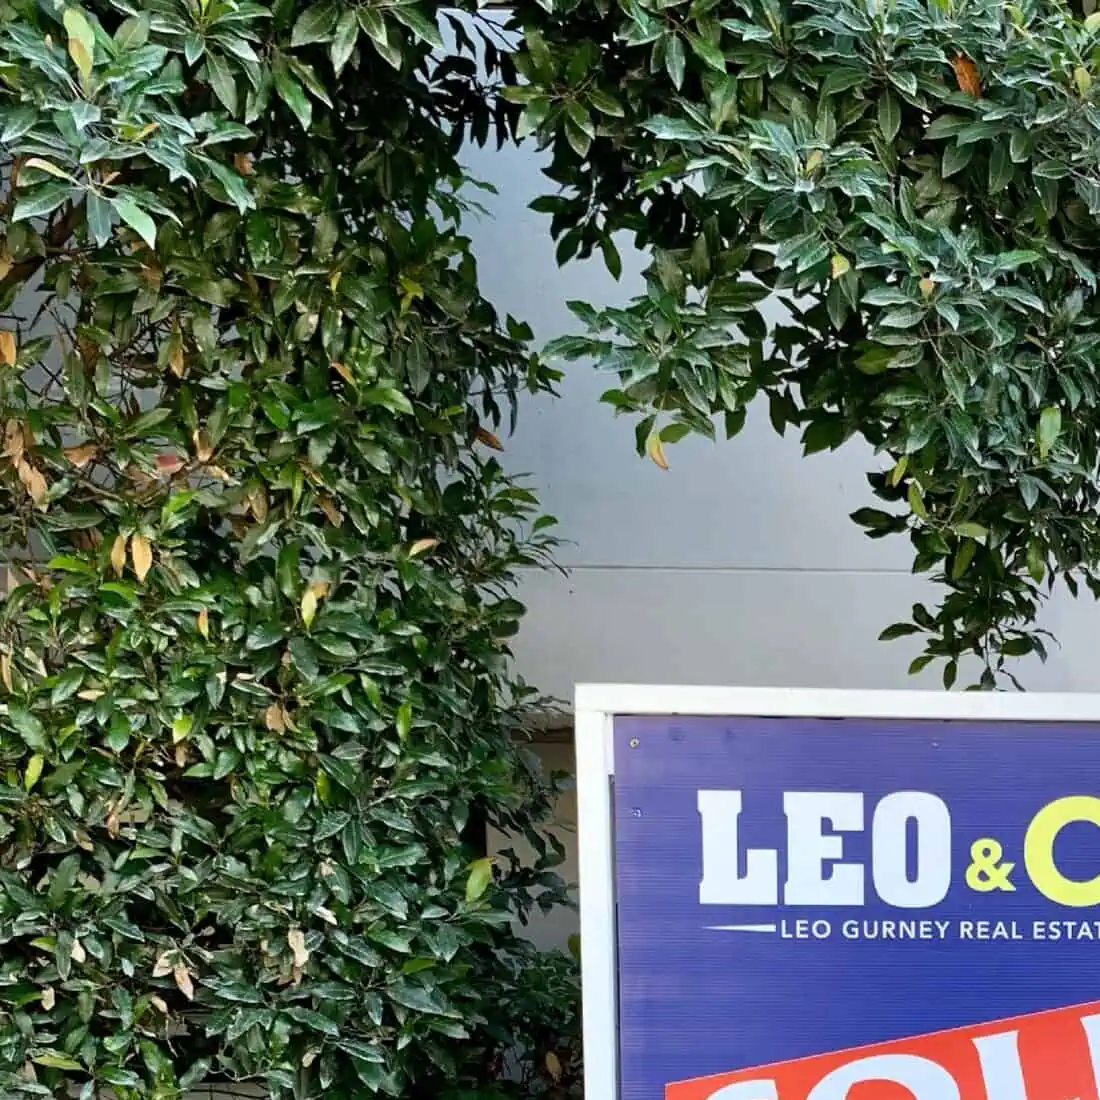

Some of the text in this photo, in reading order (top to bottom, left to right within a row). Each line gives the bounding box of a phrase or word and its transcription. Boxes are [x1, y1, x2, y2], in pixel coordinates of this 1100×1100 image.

[697, 789, 952, 908] LEO
[780, 919, 833, 940] LEO
[842, 919, 950, 940] GURNEY
[960, 920, 1023, 941] REAL
